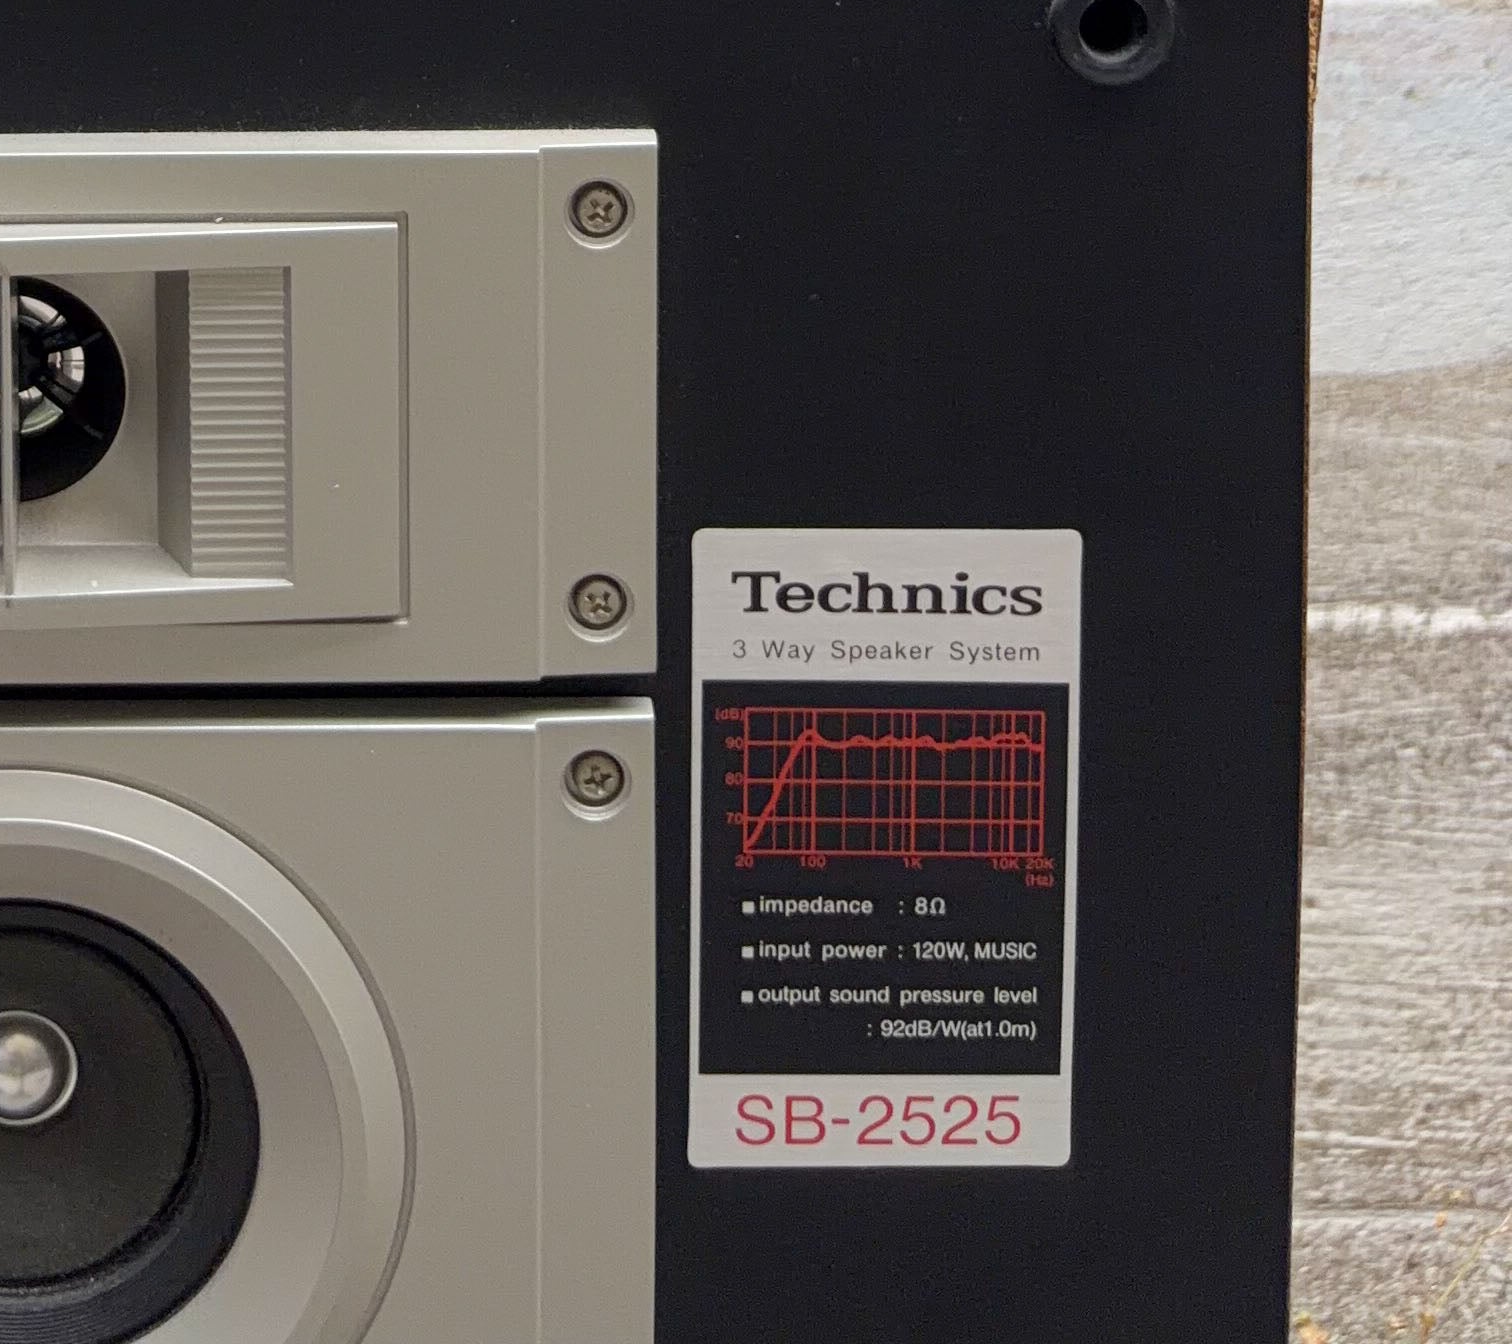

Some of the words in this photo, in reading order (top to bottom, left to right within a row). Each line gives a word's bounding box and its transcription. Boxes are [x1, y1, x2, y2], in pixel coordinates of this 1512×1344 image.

[730, 570, 1043, 617] Technics
[732, 639, 748, 659] 3
[762, 639, 816, 664] Way
[830, 640, 934, 664] Speaker
[949, 640, 1041, 666] System
[800, 855, 826, 868] 100
[758, 896, 874, 916] impedance
[758, 942, 811, 959] input
[821, 945, 887, 961] power
[912, 942, 970, 962] 120W,
[974, 942, 1037, 960] MUSIC
[758, 987, 821, 1005] output
[829, 986, 889, 1004] sound
[899, 989, 985, 1005] pressure
[993, 986, 1038, 1004] level
[734, 1093, 1022, 1146] SB-2525
